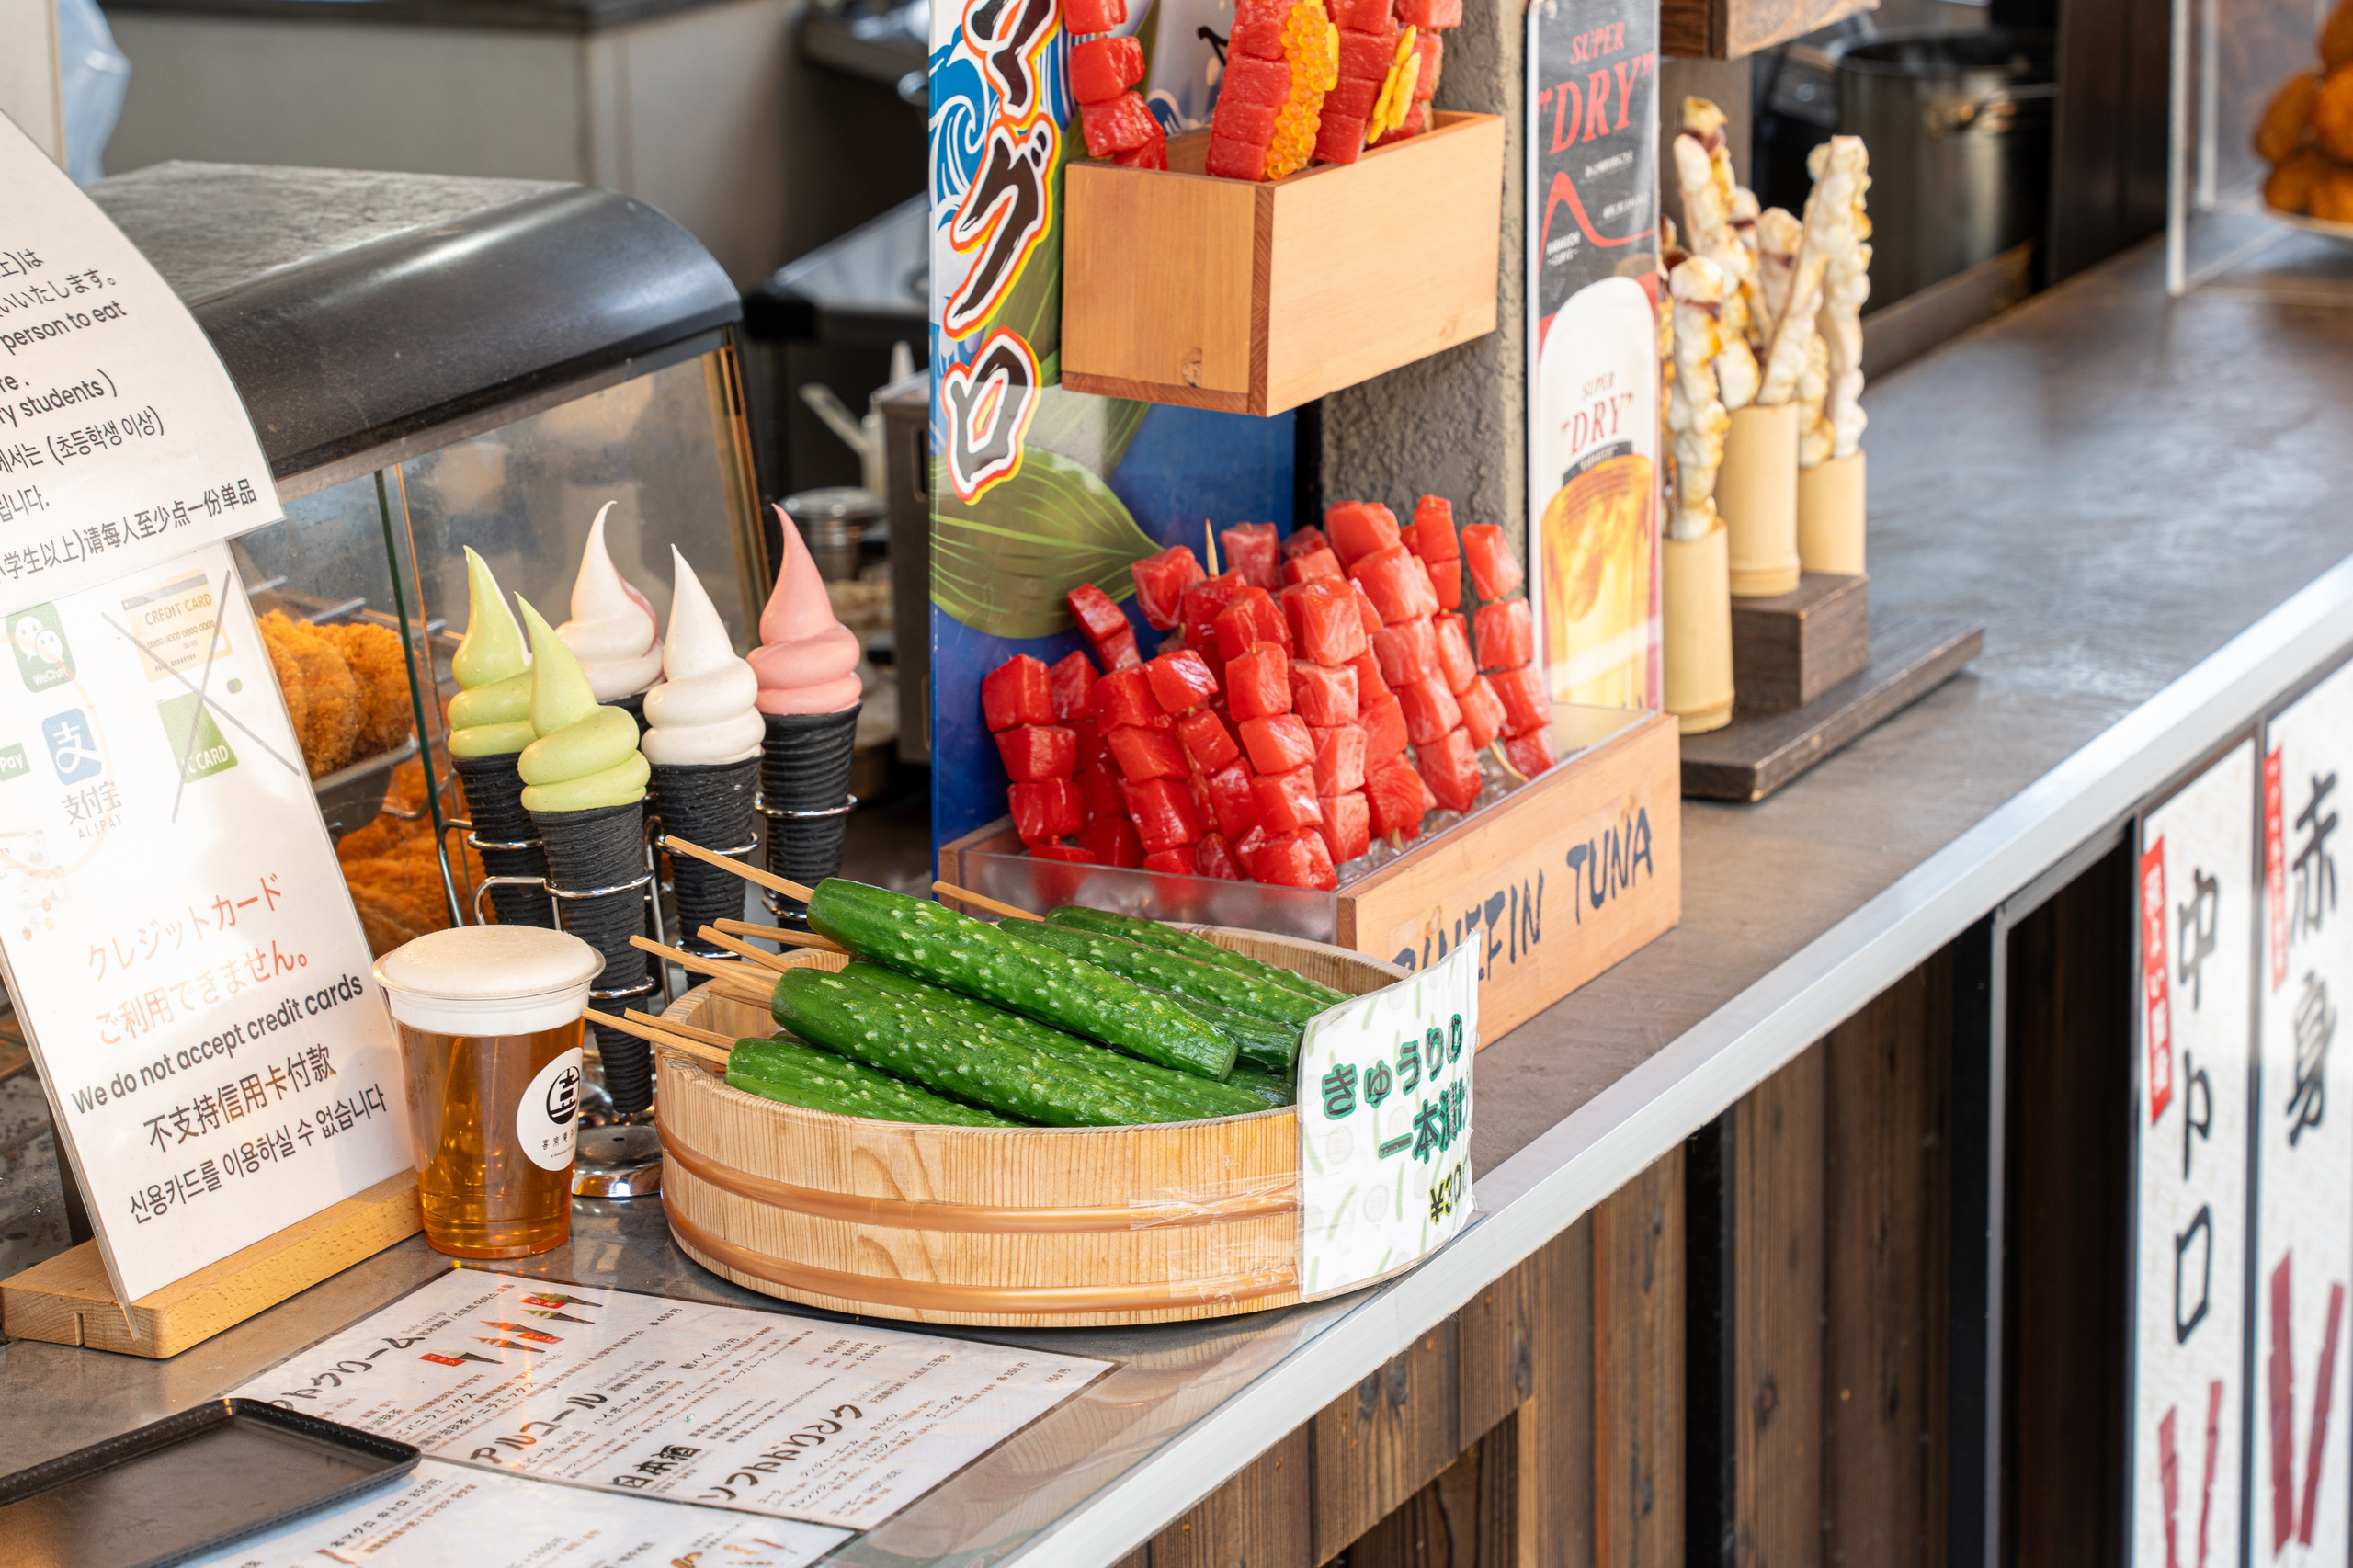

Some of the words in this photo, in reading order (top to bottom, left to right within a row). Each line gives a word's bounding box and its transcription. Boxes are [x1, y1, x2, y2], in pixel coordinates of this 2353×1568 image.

[1569, 21, 1626, 66] SUPER
[0, 319, 71, 356] person
[65, 313, 92, 330] to
[91, 301, 128, 323] eat
[1582, 371, 1616, 402] SUPER
[0, 478, 258, 581] 学生以上)请每人至少点一份单品
[144, 602, 182, 626] CREDIT
[184, 592, 213, 613] CARD
[31, 666, 69, 686] WeChat
[61, 781, 123, 825] 支付宝
[197, 744, 229, 770] CARD
[78, 813, 123, 839] ALIPAY
[1565, 806, 1654, 926] TUNA
[87, 872, 282, 982] クレジットカード
[2286, 771, 2339, 1149] 赤身
[96, 939, 309, 1046] ご利用できません。
[71, 1085, 108, 1115] We
[110, 1072, 138, 1100] do
[140, 1053, 176, 1088] not
[176, 1023, 246, 1070] accept
[246, 998, 305, 1040] credit
[304, 973, 365, 1016] cards
[1322, 1014, 1463, 1121] きゅうりの
[142, 1042, 338, 1154] 不支持信用卡付款
[2176, 867, 2220, 1345] 中トロ
[130, 1158, 223, 1225] 신용카드를
[222, 1123, 297, 1180] 이용하실
[297, 1117, 316, 1149] 수
[314, 1083, 389, 1140] 없습니다
[470, 1393, 608, 1464] アルコール
[612, 1444, 702, 1489] 日本酒
[697, 1404, 863, 1501] ソフトドリンク
